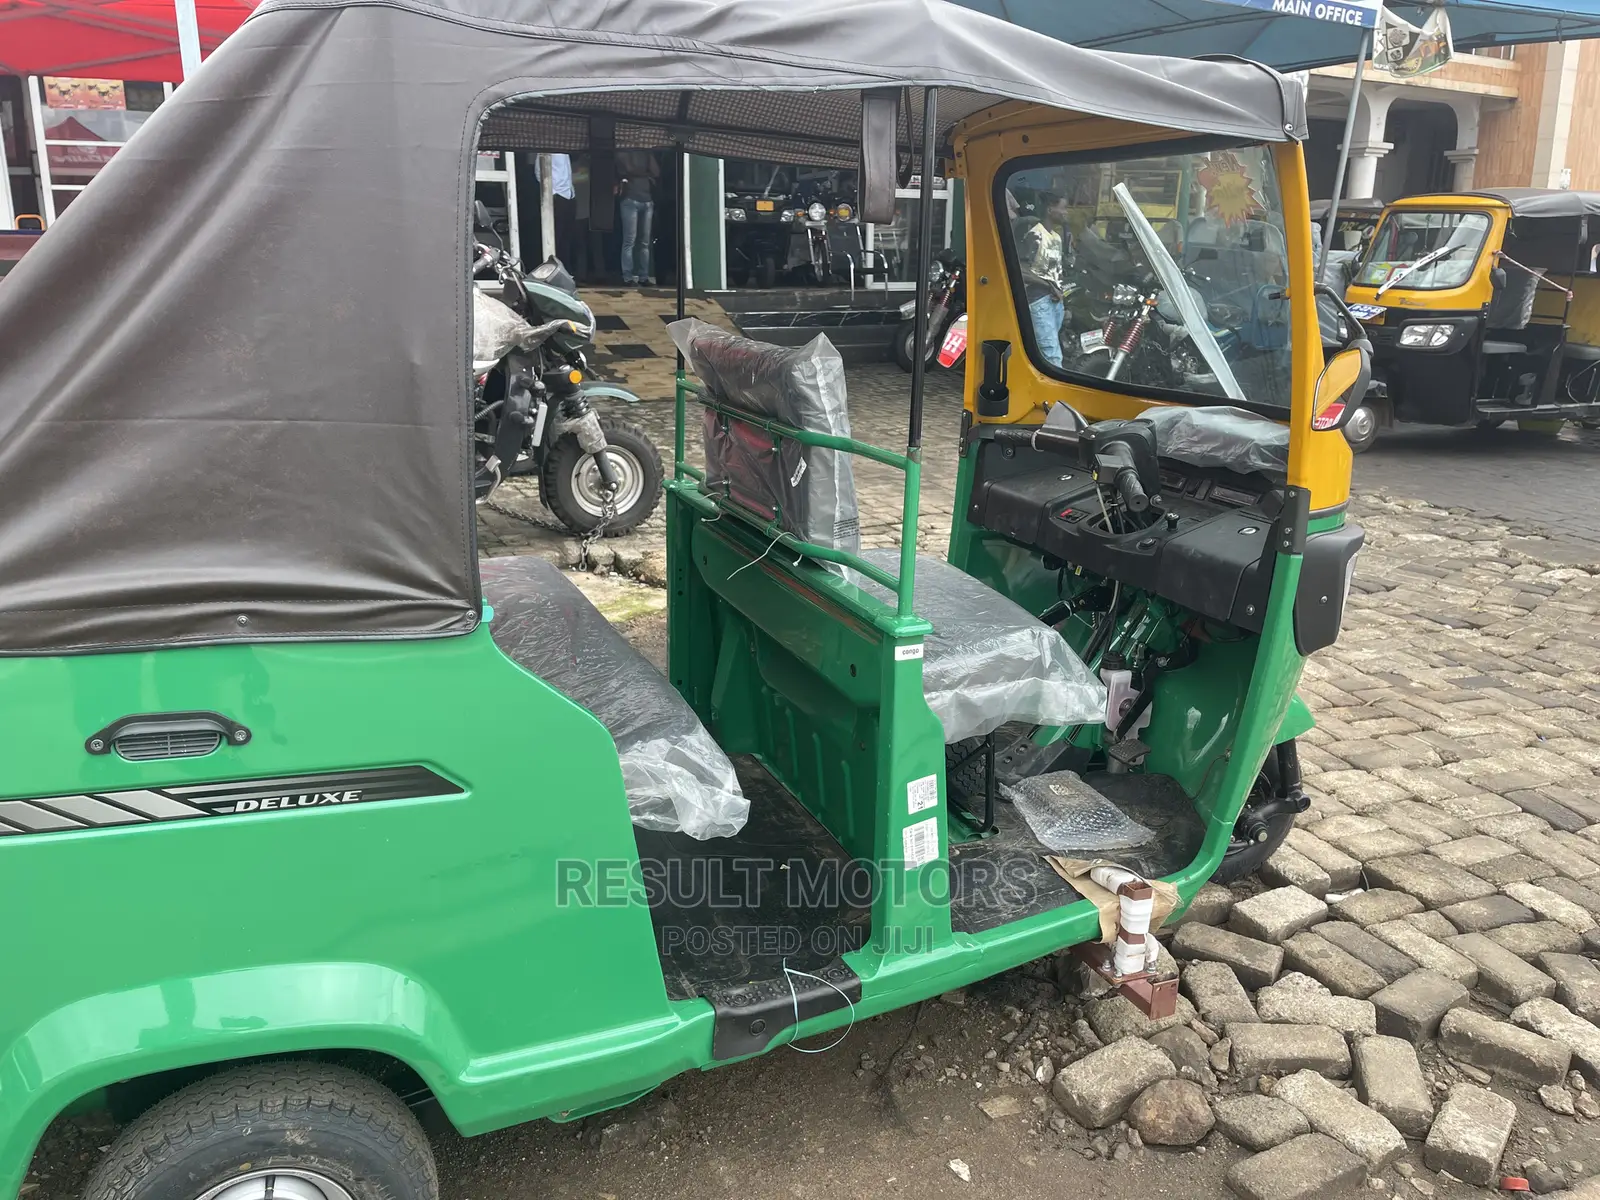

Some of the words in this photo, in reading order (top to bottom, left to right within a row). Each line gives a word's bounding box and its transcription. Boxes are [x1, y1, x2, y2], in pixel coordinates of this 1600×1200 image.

[1272, 0, 1311, 17] MAIN
[1314, 3, 1363, 26] OFFICE
[235, 790, 362, 812] DELUXE
